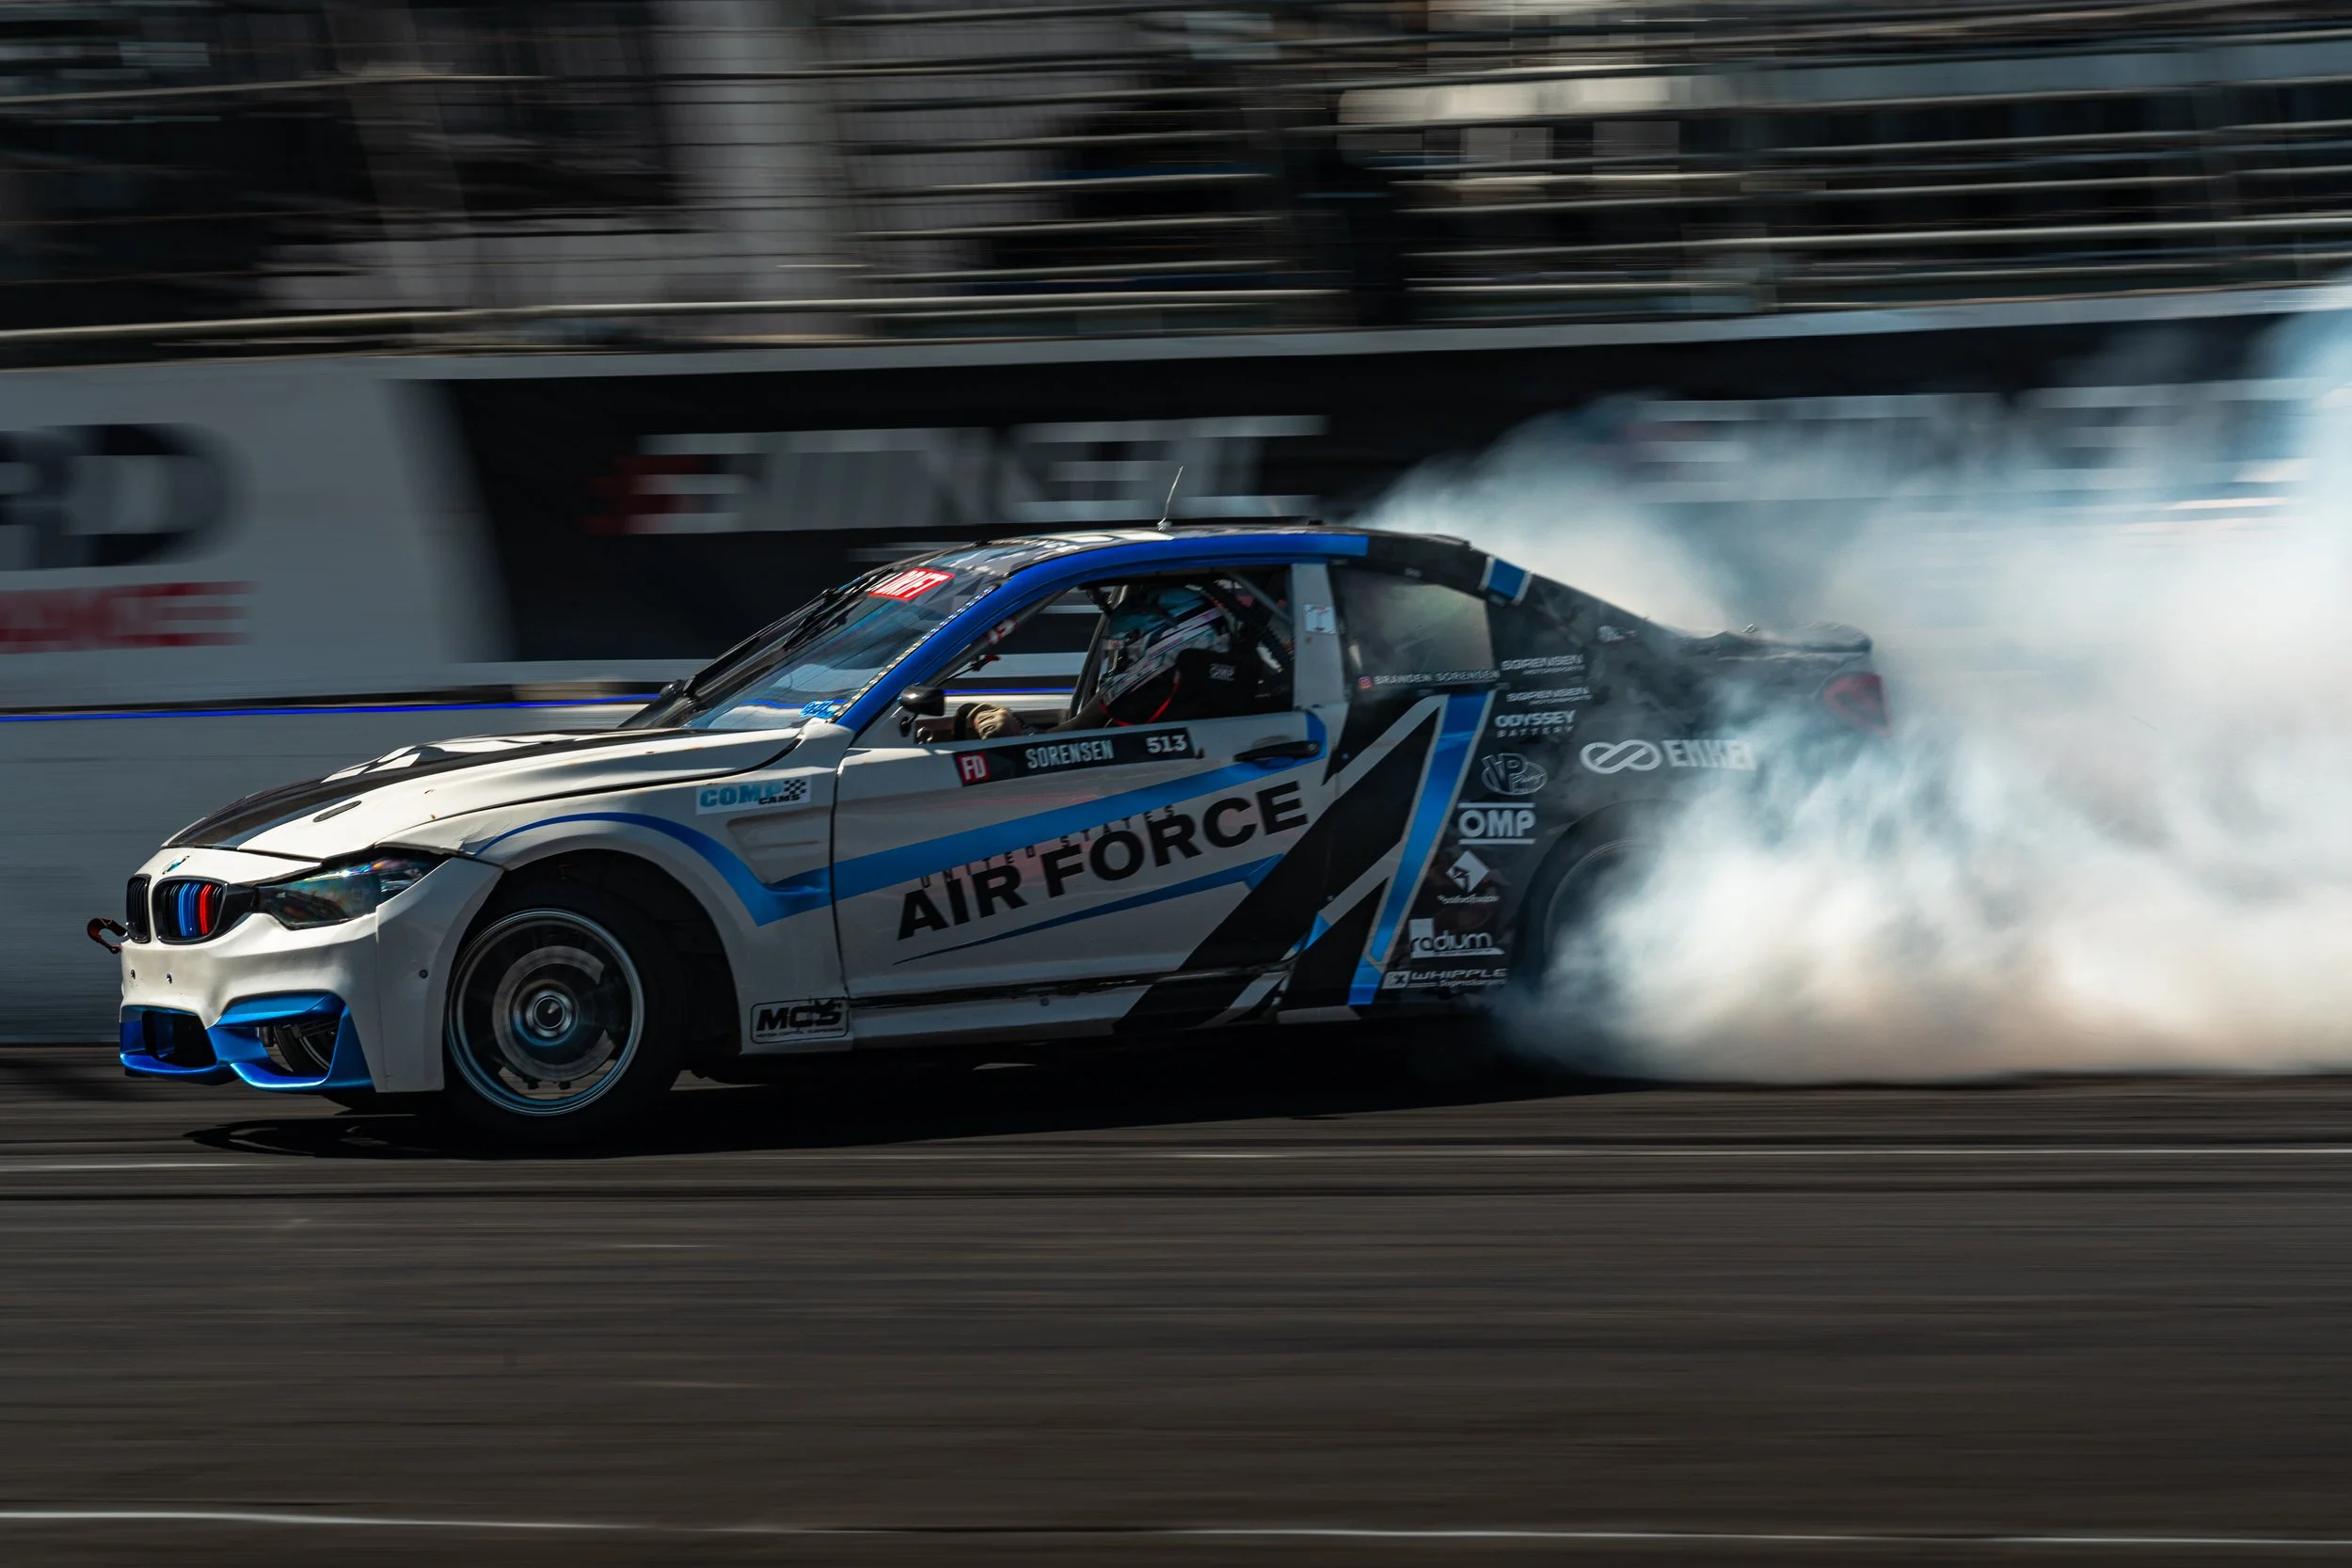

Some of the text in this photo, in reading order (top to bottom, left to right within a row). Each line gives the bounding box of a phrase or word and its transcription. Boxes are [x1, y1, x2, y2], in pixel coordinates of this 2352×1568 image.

[868, 568, 953, 599] DRIFT
[1501, 654, 1583, 671] SORENSEN
[1374, 669, 1501, 685] BRANDEN SORENSEN
[1506, 686, 1590, 702] SORENSEN
[1495, 709, 1576, 728] ODYSSEY
[1497, 725, 1575, 738] BATTERY
[1025, 739, 1114, 769] SORENSEN
[1146, 735, 1187, 753] 513
[961, 755, 986, 781] FD
[700, 782, 783, 808] COMP
[758, 793, 801, 805] CAMS
[1458, 809, 1536, 838] OMP
[920, 804, 1175, 889] UNITED STATES
[898, 781, 1309, 941] AIR FORCE
[1411, 930, 1493, 952] radium
[1412, 968, 1508, 980] WHIPPLE
[756, 1003, 842, 1032] MCS
